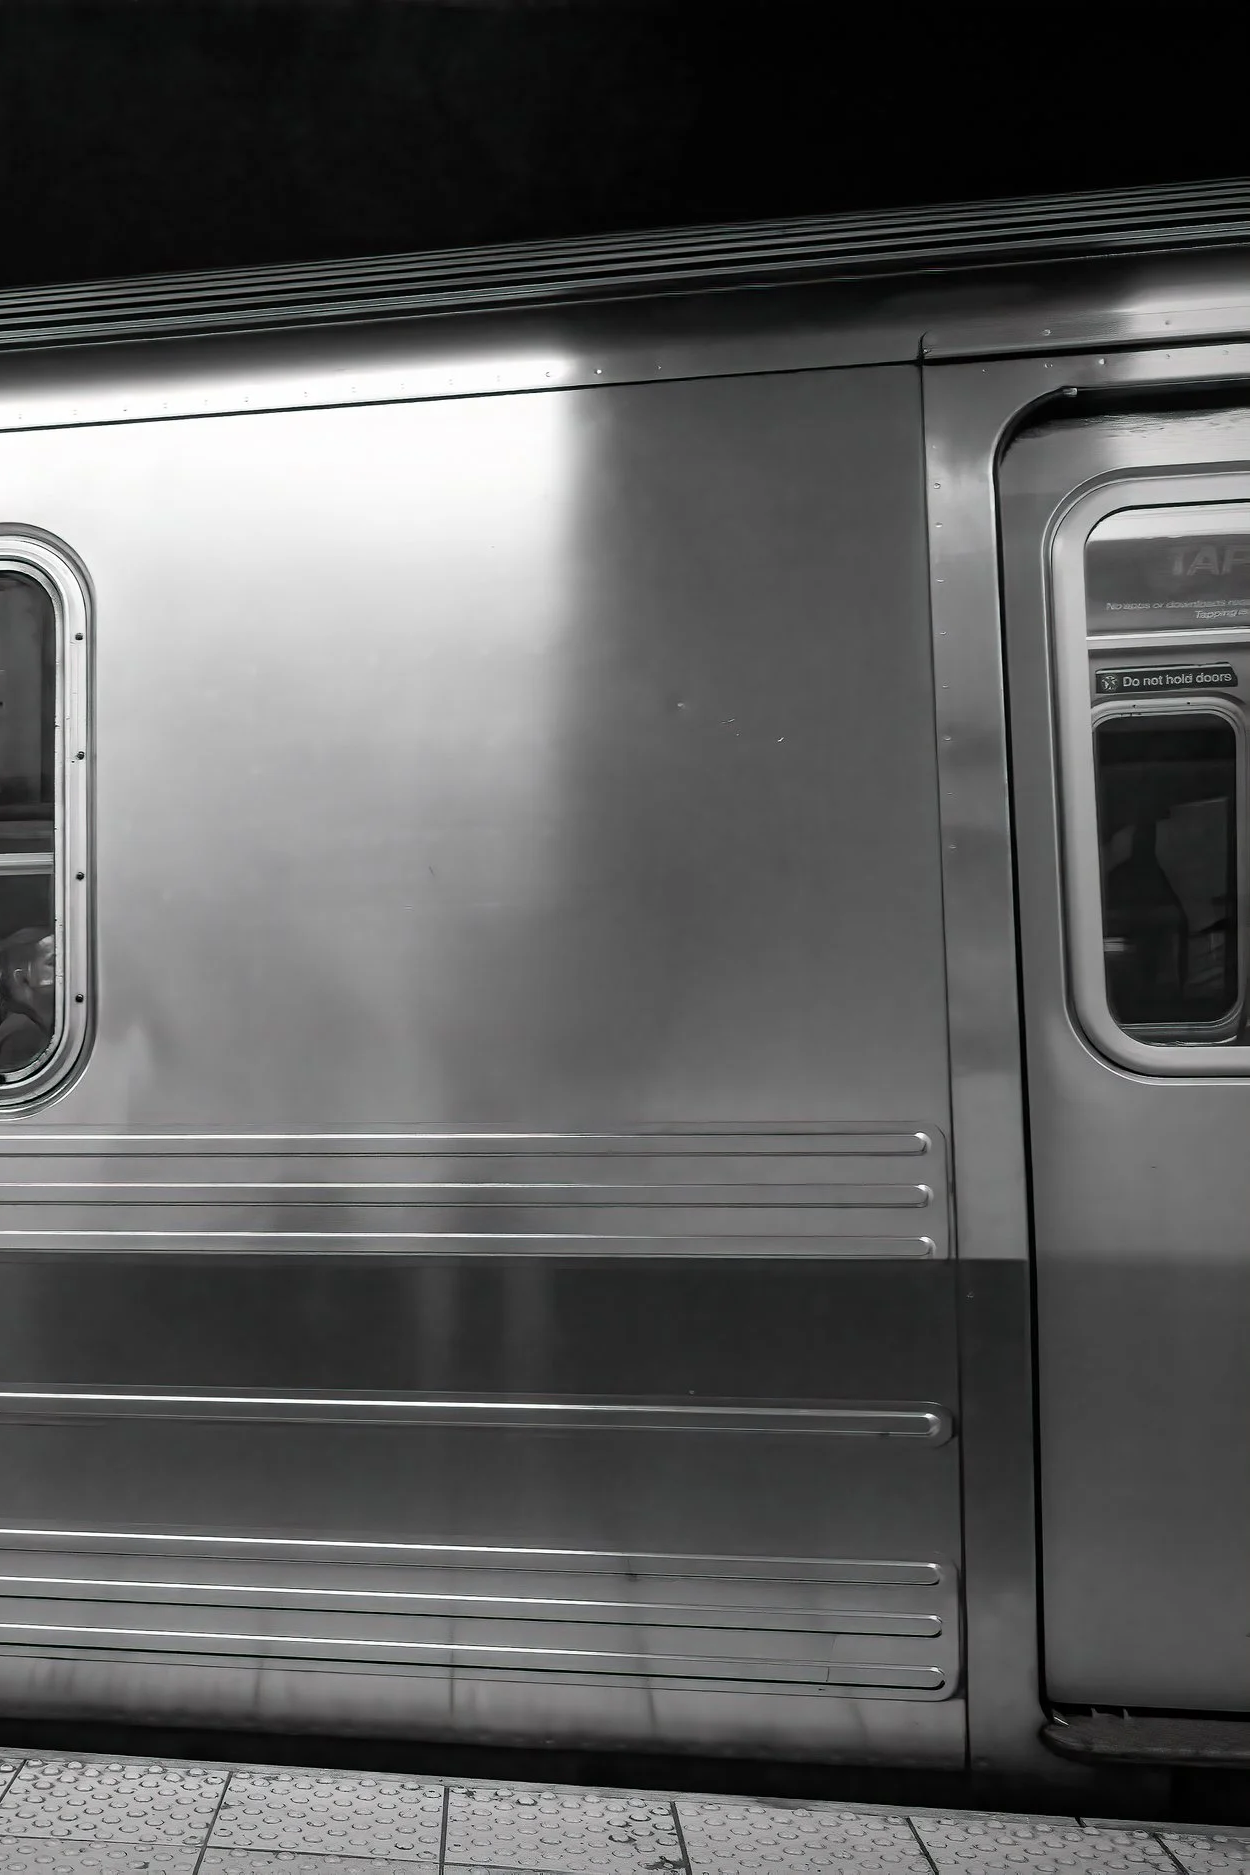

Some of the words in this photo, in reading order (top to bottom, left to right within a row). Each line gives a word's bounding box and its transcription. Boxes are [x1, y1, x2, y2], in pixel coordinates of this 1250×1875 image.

[1122, 676, 1140, 687] Do
[1142, 675, 1163, 686] not
[1165, 673, 1193, 685] hold
[1195, 672, 1233, 684] doors
